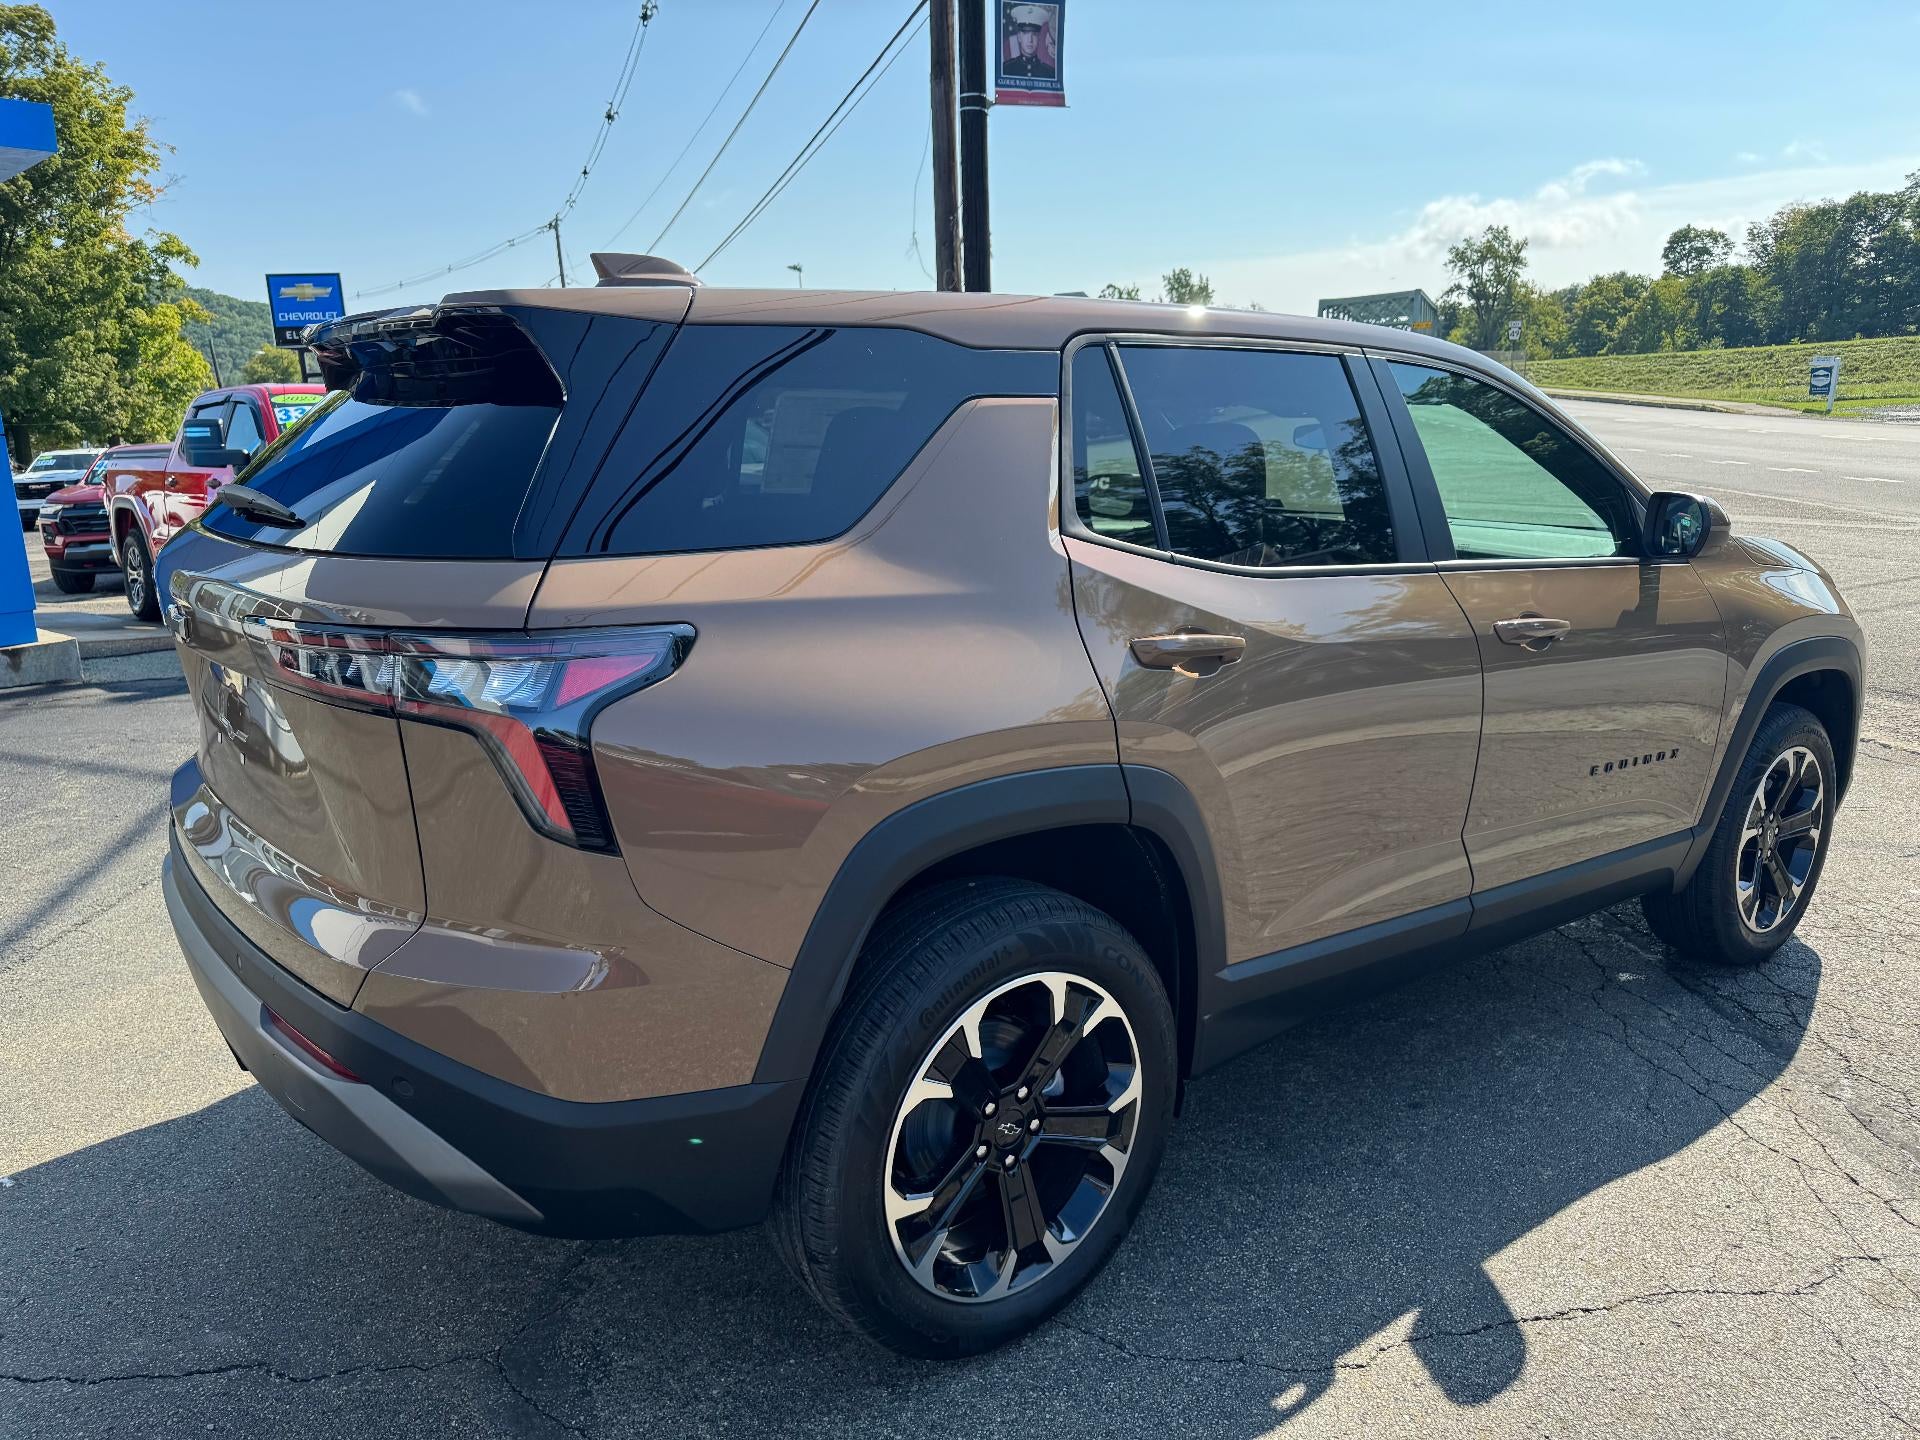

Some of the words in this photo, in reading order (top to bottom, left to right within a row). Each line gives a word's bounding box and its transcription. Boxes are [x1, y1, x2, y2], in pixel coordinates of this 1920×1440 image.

[278, 311, 338, 321] CHEVROLET
[1589, 748, 1680, 777] EQUINOX
[919, 950, 1001, 1030] Continental
